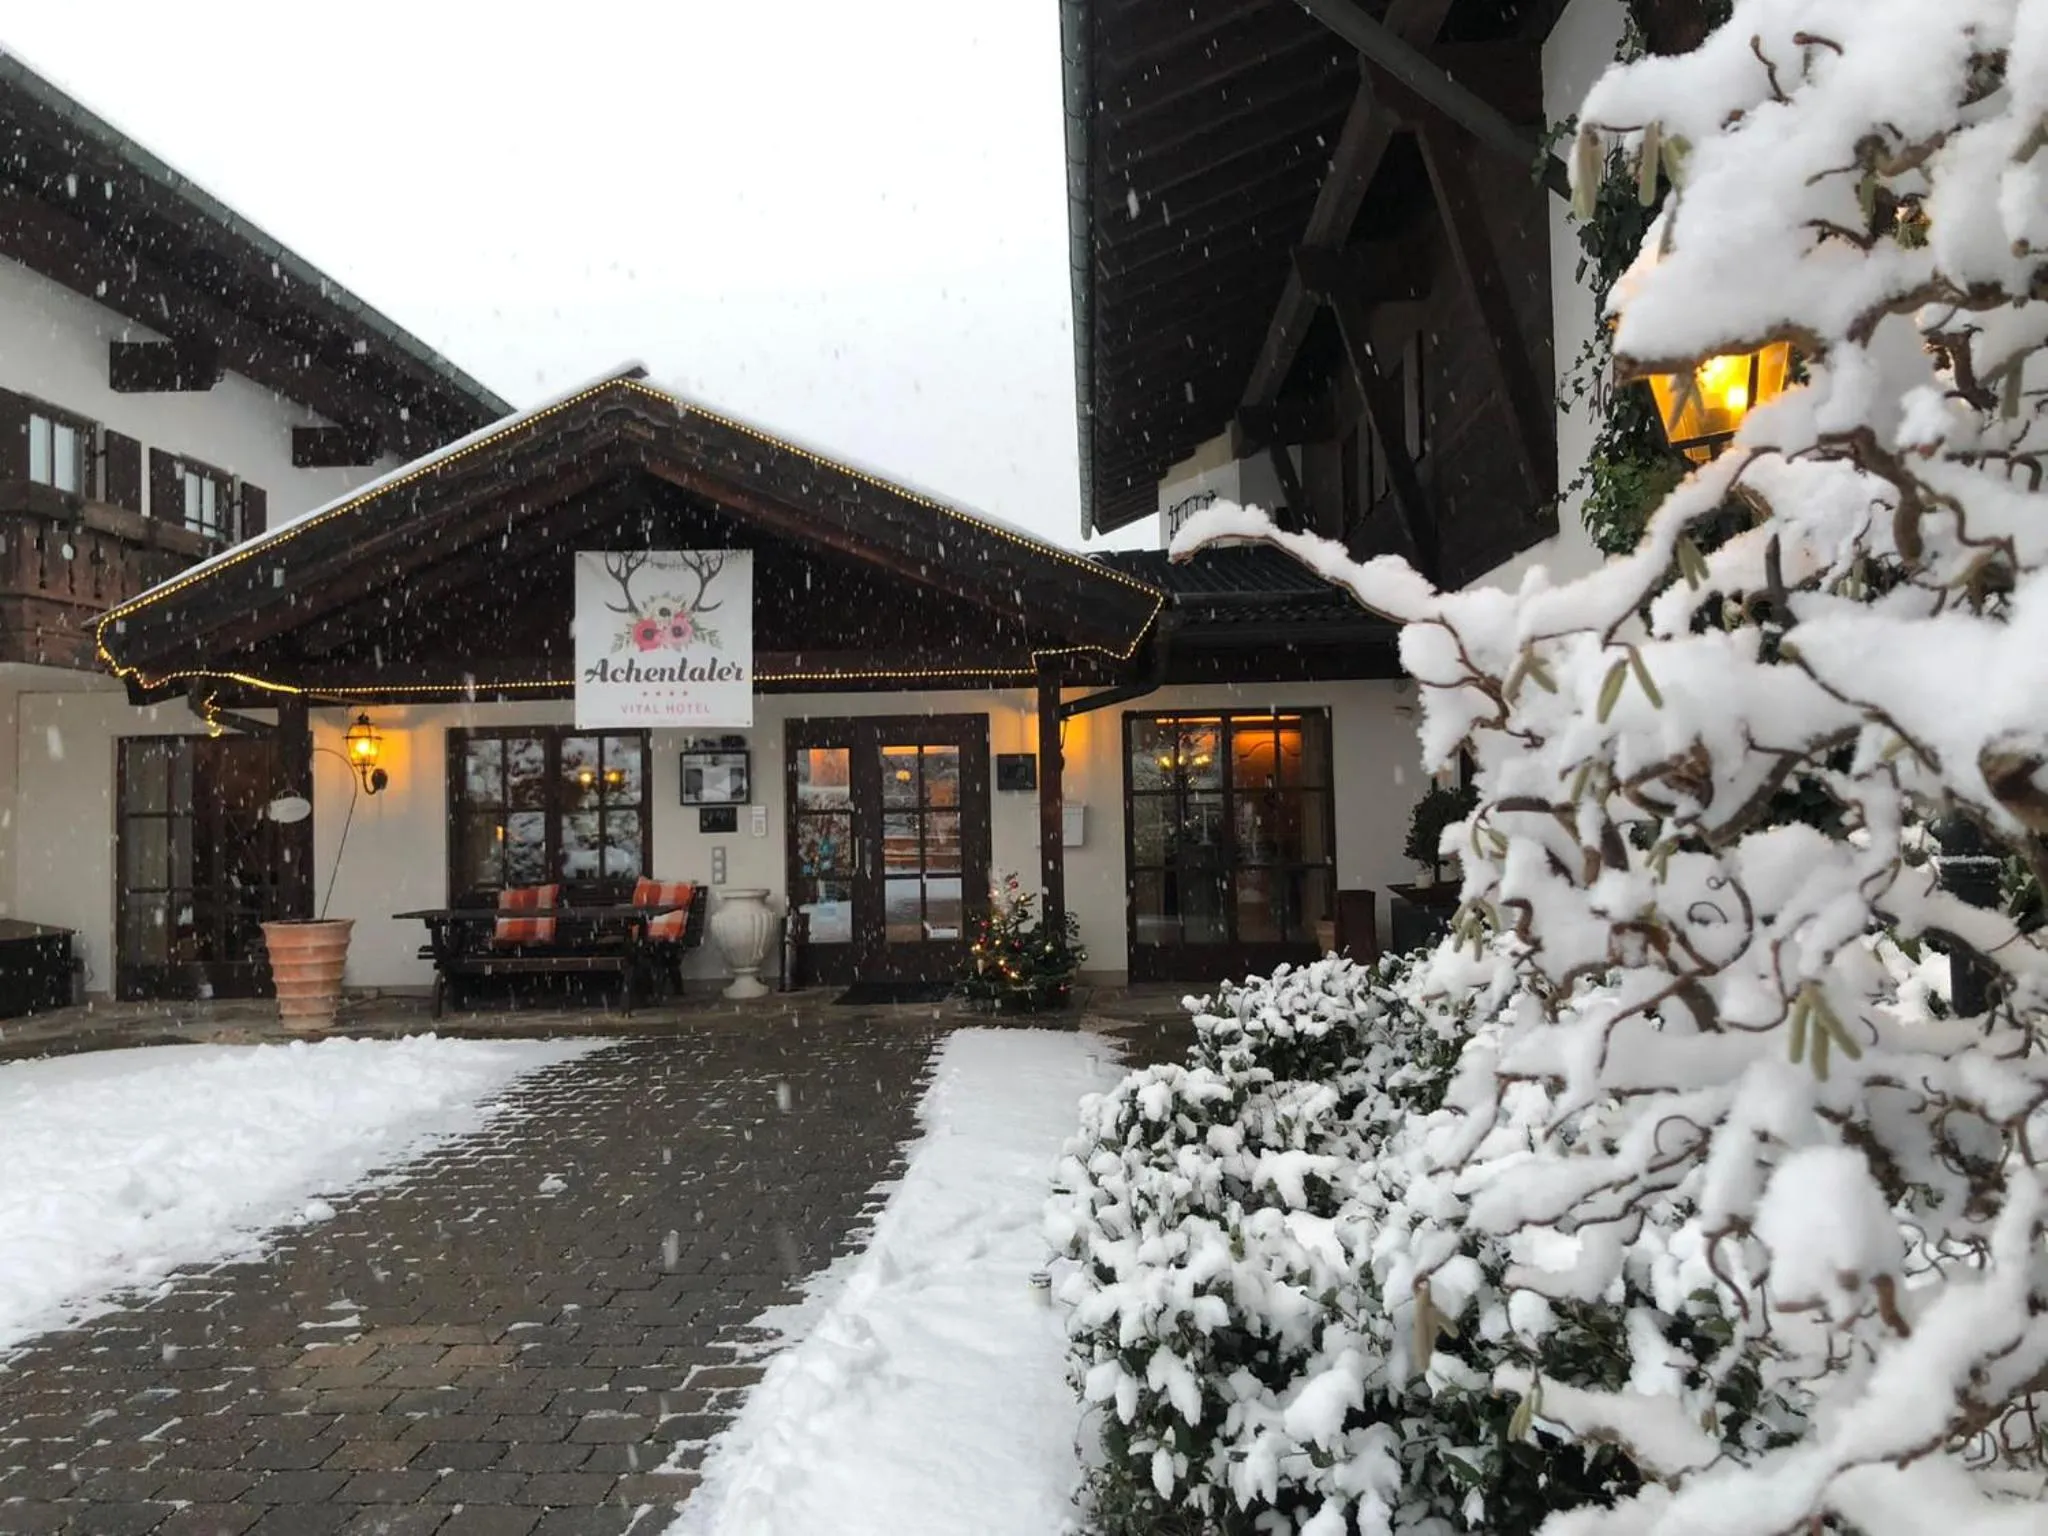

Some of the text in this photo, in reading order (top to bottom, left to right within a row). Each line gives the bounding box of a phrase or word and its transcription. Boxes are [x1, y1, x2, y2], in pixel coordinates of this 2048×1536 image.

[584, 656, 744, 684] Achentaler
[620, 702, 711, 714] VITAL HOTEL
